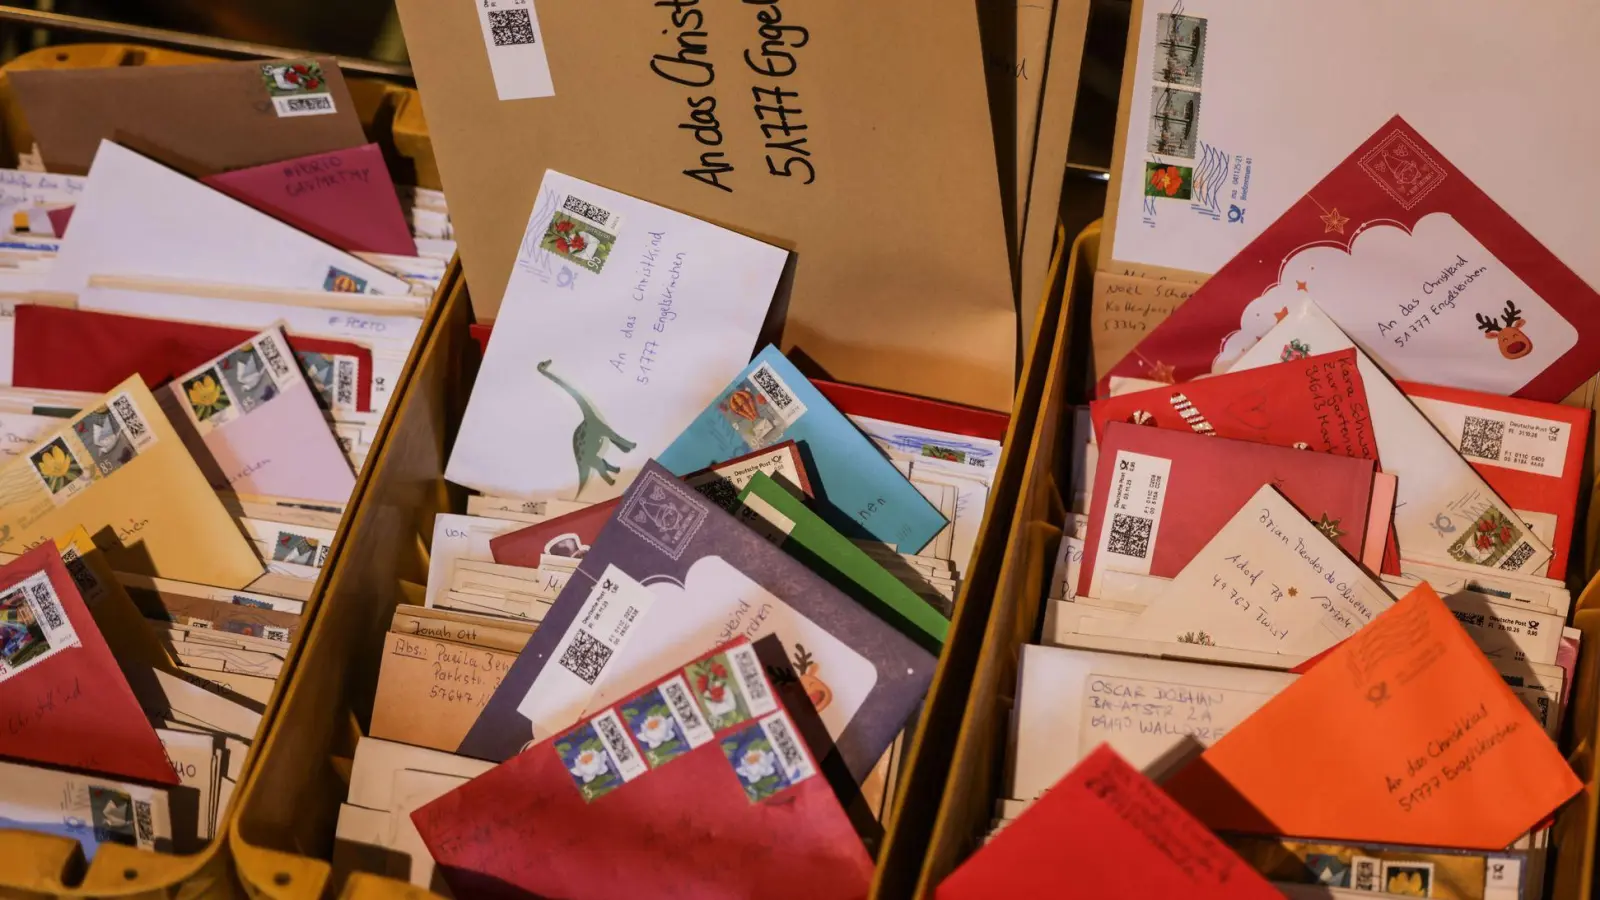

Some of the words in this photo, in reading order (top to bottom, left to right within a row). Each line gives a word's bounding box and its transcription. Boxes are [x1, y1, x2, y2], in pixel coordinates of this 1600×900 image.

[678, 96, 722, 145] das
[752, 86, 815, 185] 51777
[682, 152, 734, 192] An
[610, 352, 627, 374] An
[620, 315, 636, 339] das
[632, 232, 666, 301] Christkind
[1378, 319, 1398, 336] An
[1399, 298, 1420, 317] das
[1422, 254, 1468, 295] Christkind
[1430, 266, 1487, 316] Engelskirchen
[636, 340, 660, 385] 51777
[1510, 420, 1534, 430] Deutsche
[100, 459, 113, 473] 85
[734, 465, 758, 476] Deutsche
[1114, 484, 1122, 508] Deutsche
[582, 601, 598, 624] Deutsche
[596, 591, 606, 602] Post
[1490, 616, 1514, 624] Deutsche
[457, 629, 477, 640] Ott
[430, 685, 473, 702] 57647
[1092, 680, 1146, 698] OSCAR
[1398, 776, 1440, 812] 51777
